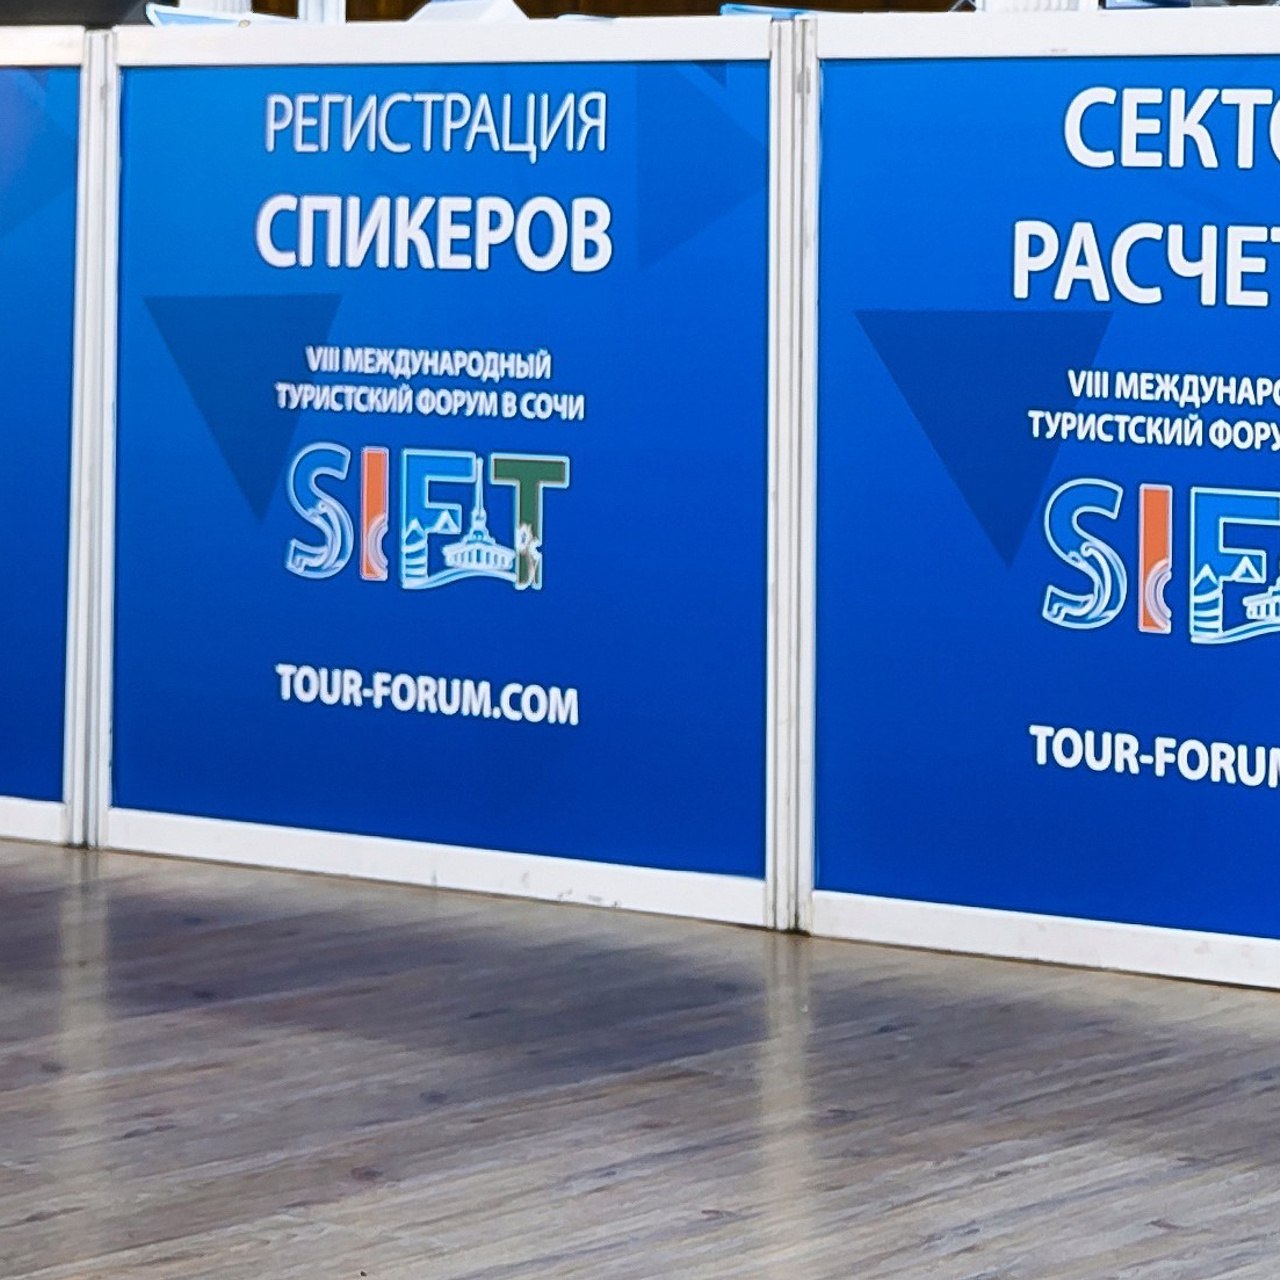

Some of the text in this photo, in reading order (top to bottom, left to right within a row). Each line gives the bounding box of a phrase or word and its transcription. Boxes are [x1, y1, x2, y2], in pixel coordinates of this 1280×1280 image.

[265, 91, 607, 164] РЕГИСТРАЦИЯ
[256, 194, 613, 272] СПИКЕРОВ
[305, 345, 552, 383] VIII МЕЖДУНАРОДНЫЙ
[1067, 369, 1109, 399] VIII
[275, 381, 585, 421] ТУРИСТСКИЙ ФОРУМ В СОЧИ
[1027, 409, 1203, 447] ТУРИСТСКИЙ
[286, 441, 570, 591] SIFT
[275, 663, 580, 726] TOUR-FORUM.COM
